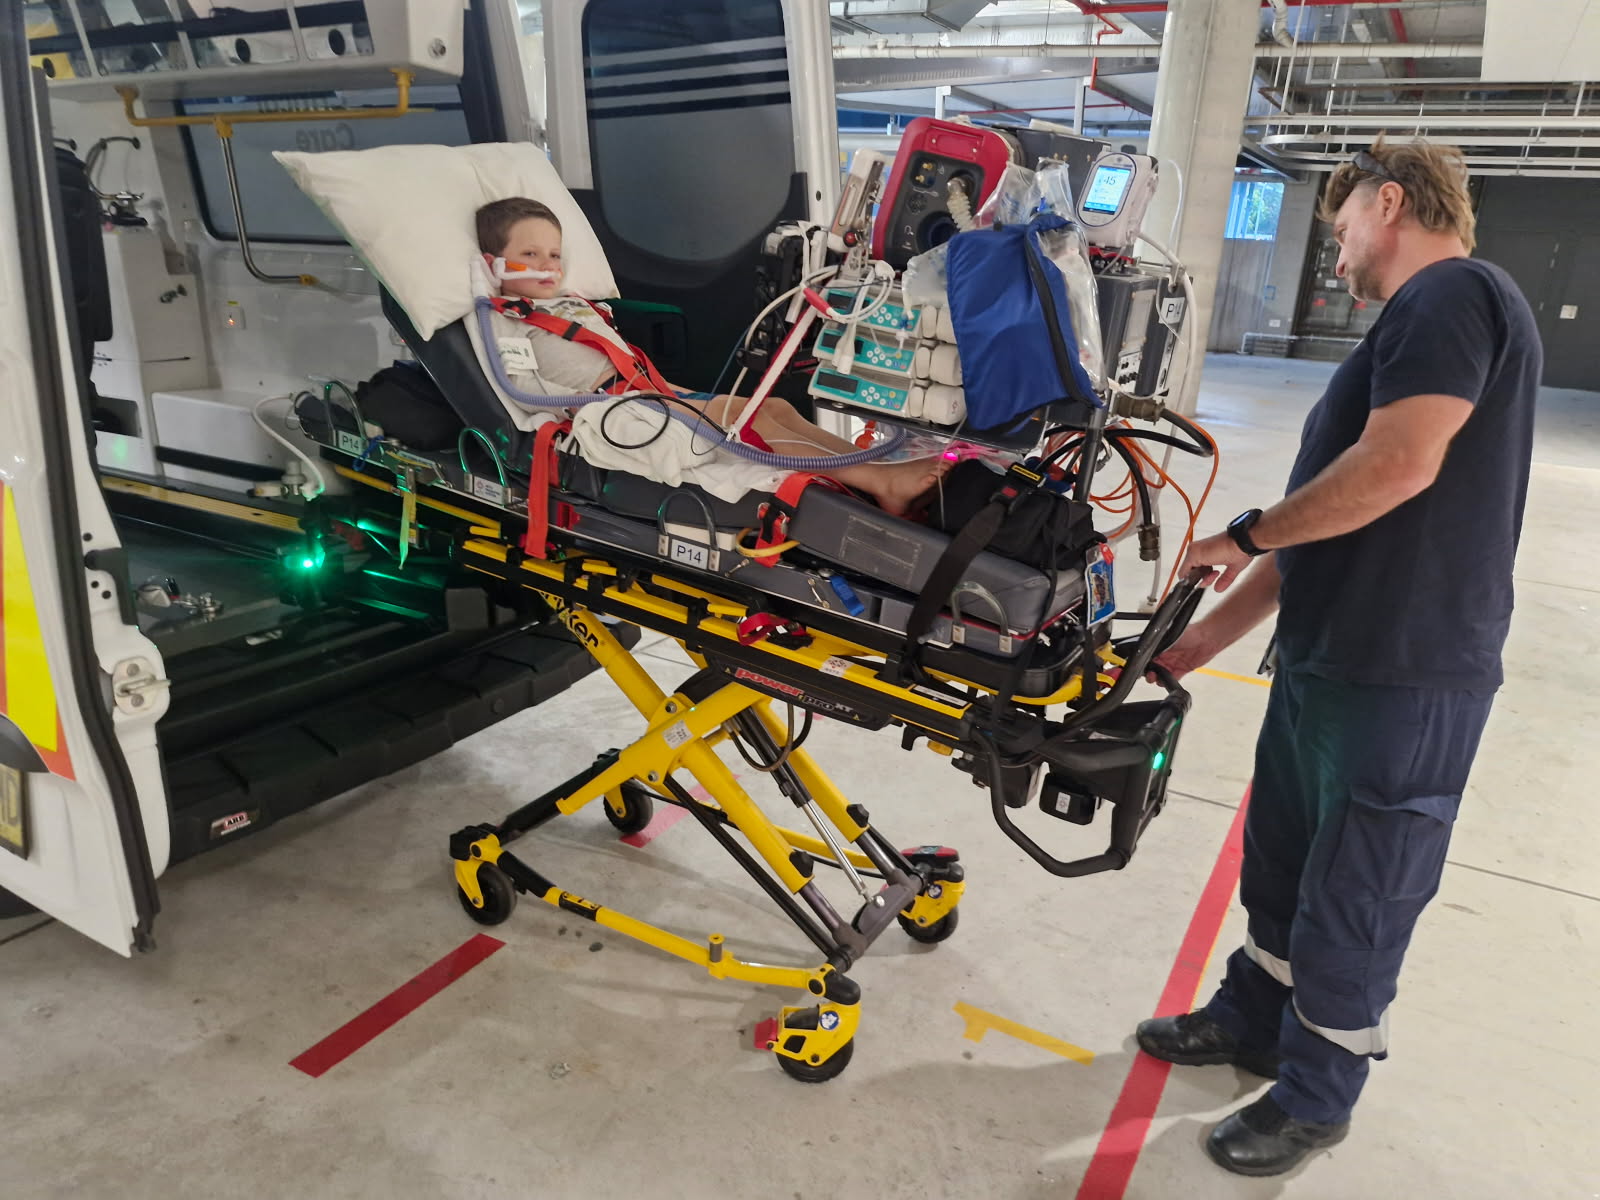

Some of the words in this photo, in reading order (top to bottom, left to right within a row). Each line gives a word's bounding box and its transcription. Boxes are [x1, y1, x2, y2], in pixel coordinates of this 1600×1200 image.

[342, 434, 360, 449] P14
[676, 544, 702, 565] P14
[735, 666, 804, 697] power
